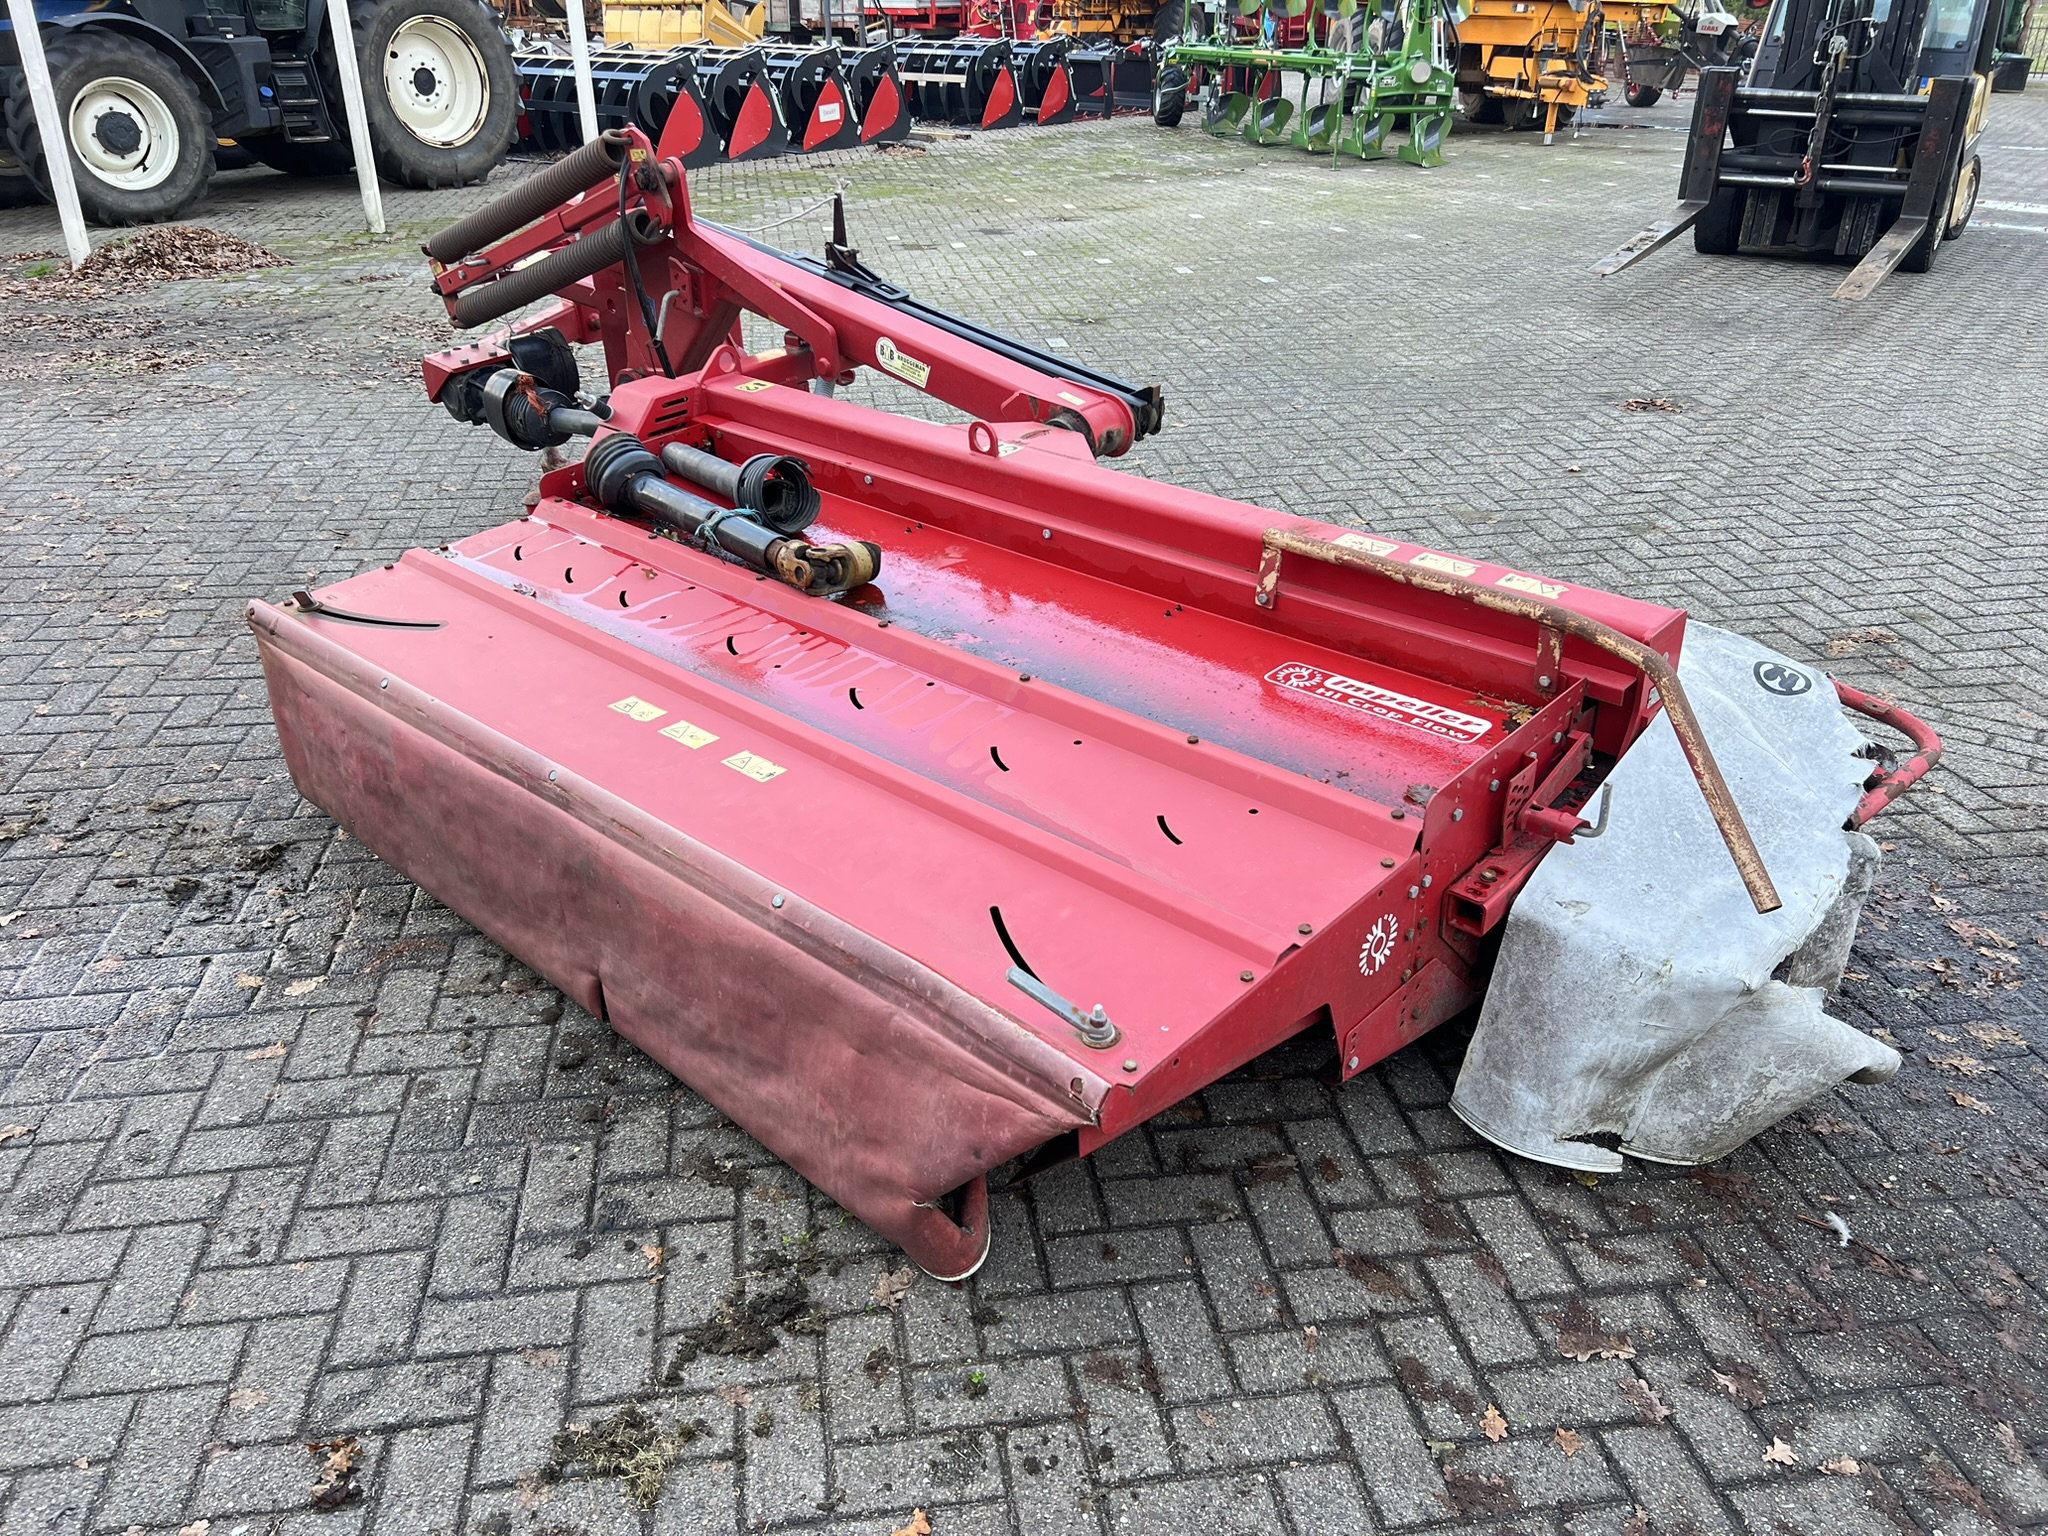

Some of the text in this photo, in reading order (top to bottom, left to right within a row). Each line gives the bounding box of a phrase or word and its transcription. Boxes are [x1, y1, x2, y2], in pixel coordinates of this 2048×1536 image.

[897, 354, 926, 372] BRUGGEMAN
[1331, 679, 1484, 728] Impeller
[1346, 697, 1404, 720] Crop
[1410, 717, 1470, 740] Flow
